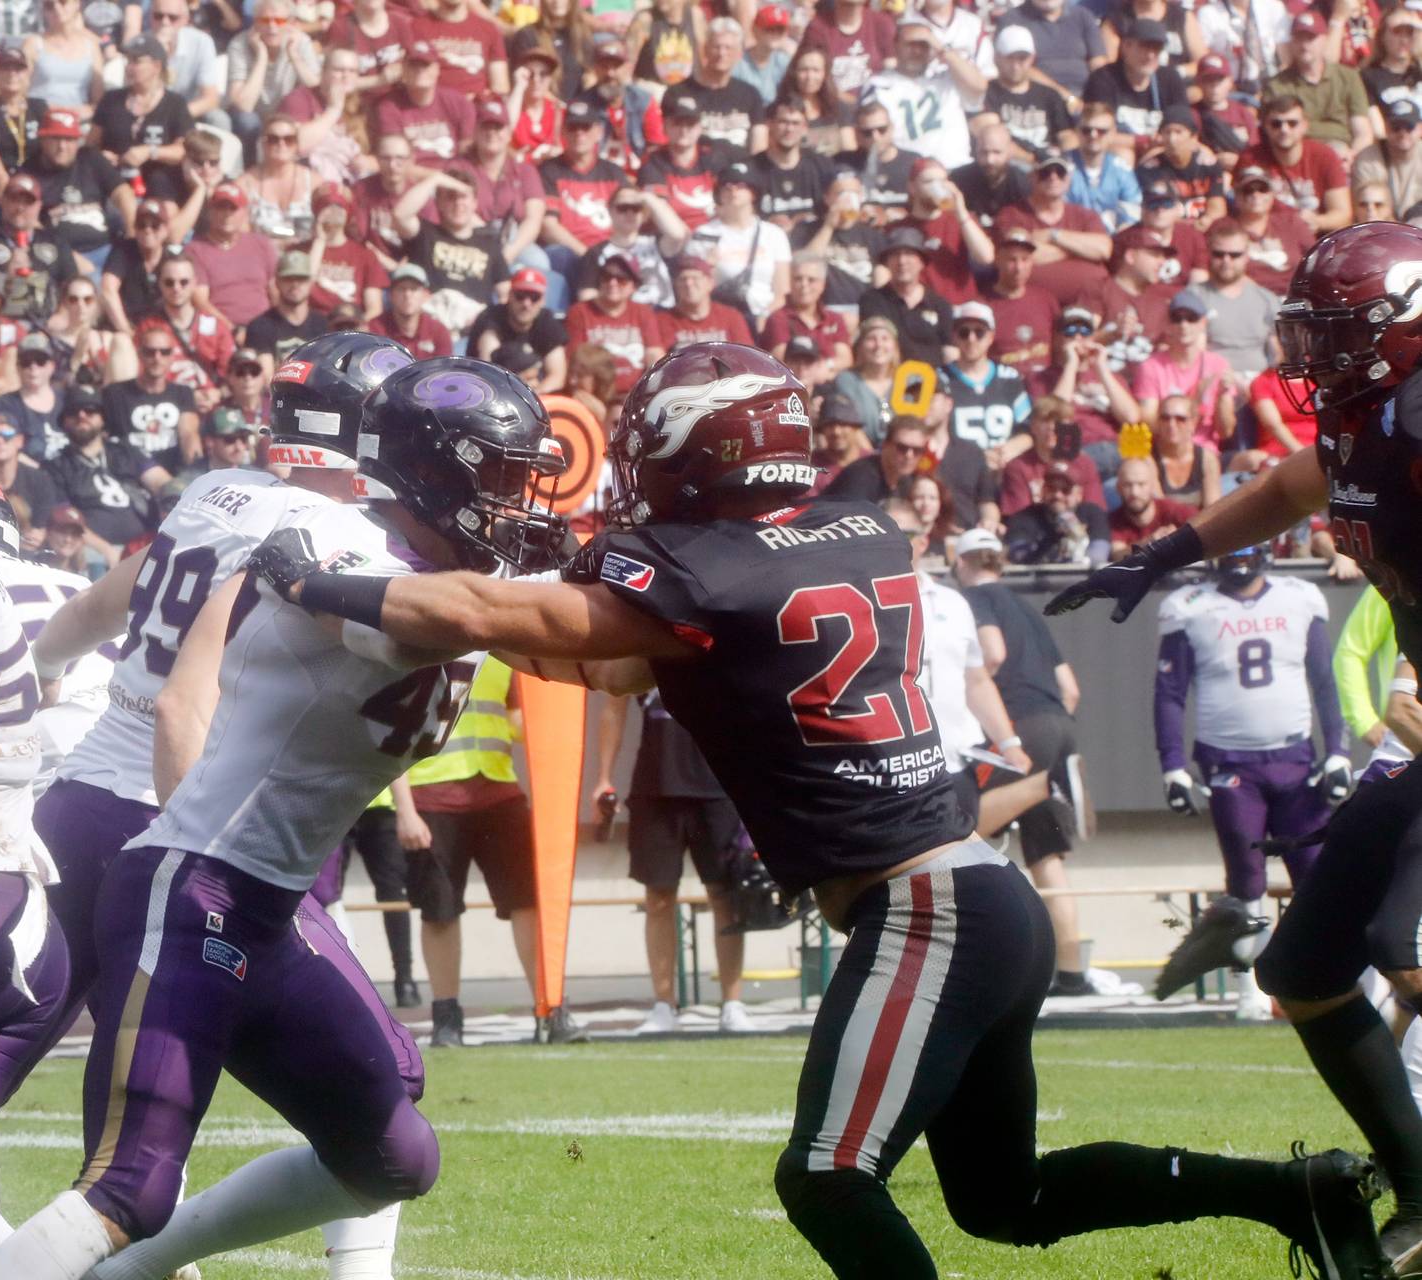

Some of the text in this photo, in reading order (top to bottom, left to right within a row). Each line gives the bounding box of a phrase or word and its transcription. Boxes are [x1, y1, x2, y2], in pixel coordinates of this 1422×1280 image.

[898, 91, 942, 141] 12
[954, 404, 1015, 450] 59
[755, 515, 887, 550] RICHTER
[1217, 617, 1288, 640] ADLER
[777, 572, 933, 746] 27
[1237, 638, 1274, 689] 8
[834, 745, 943, 774] AMERICA
